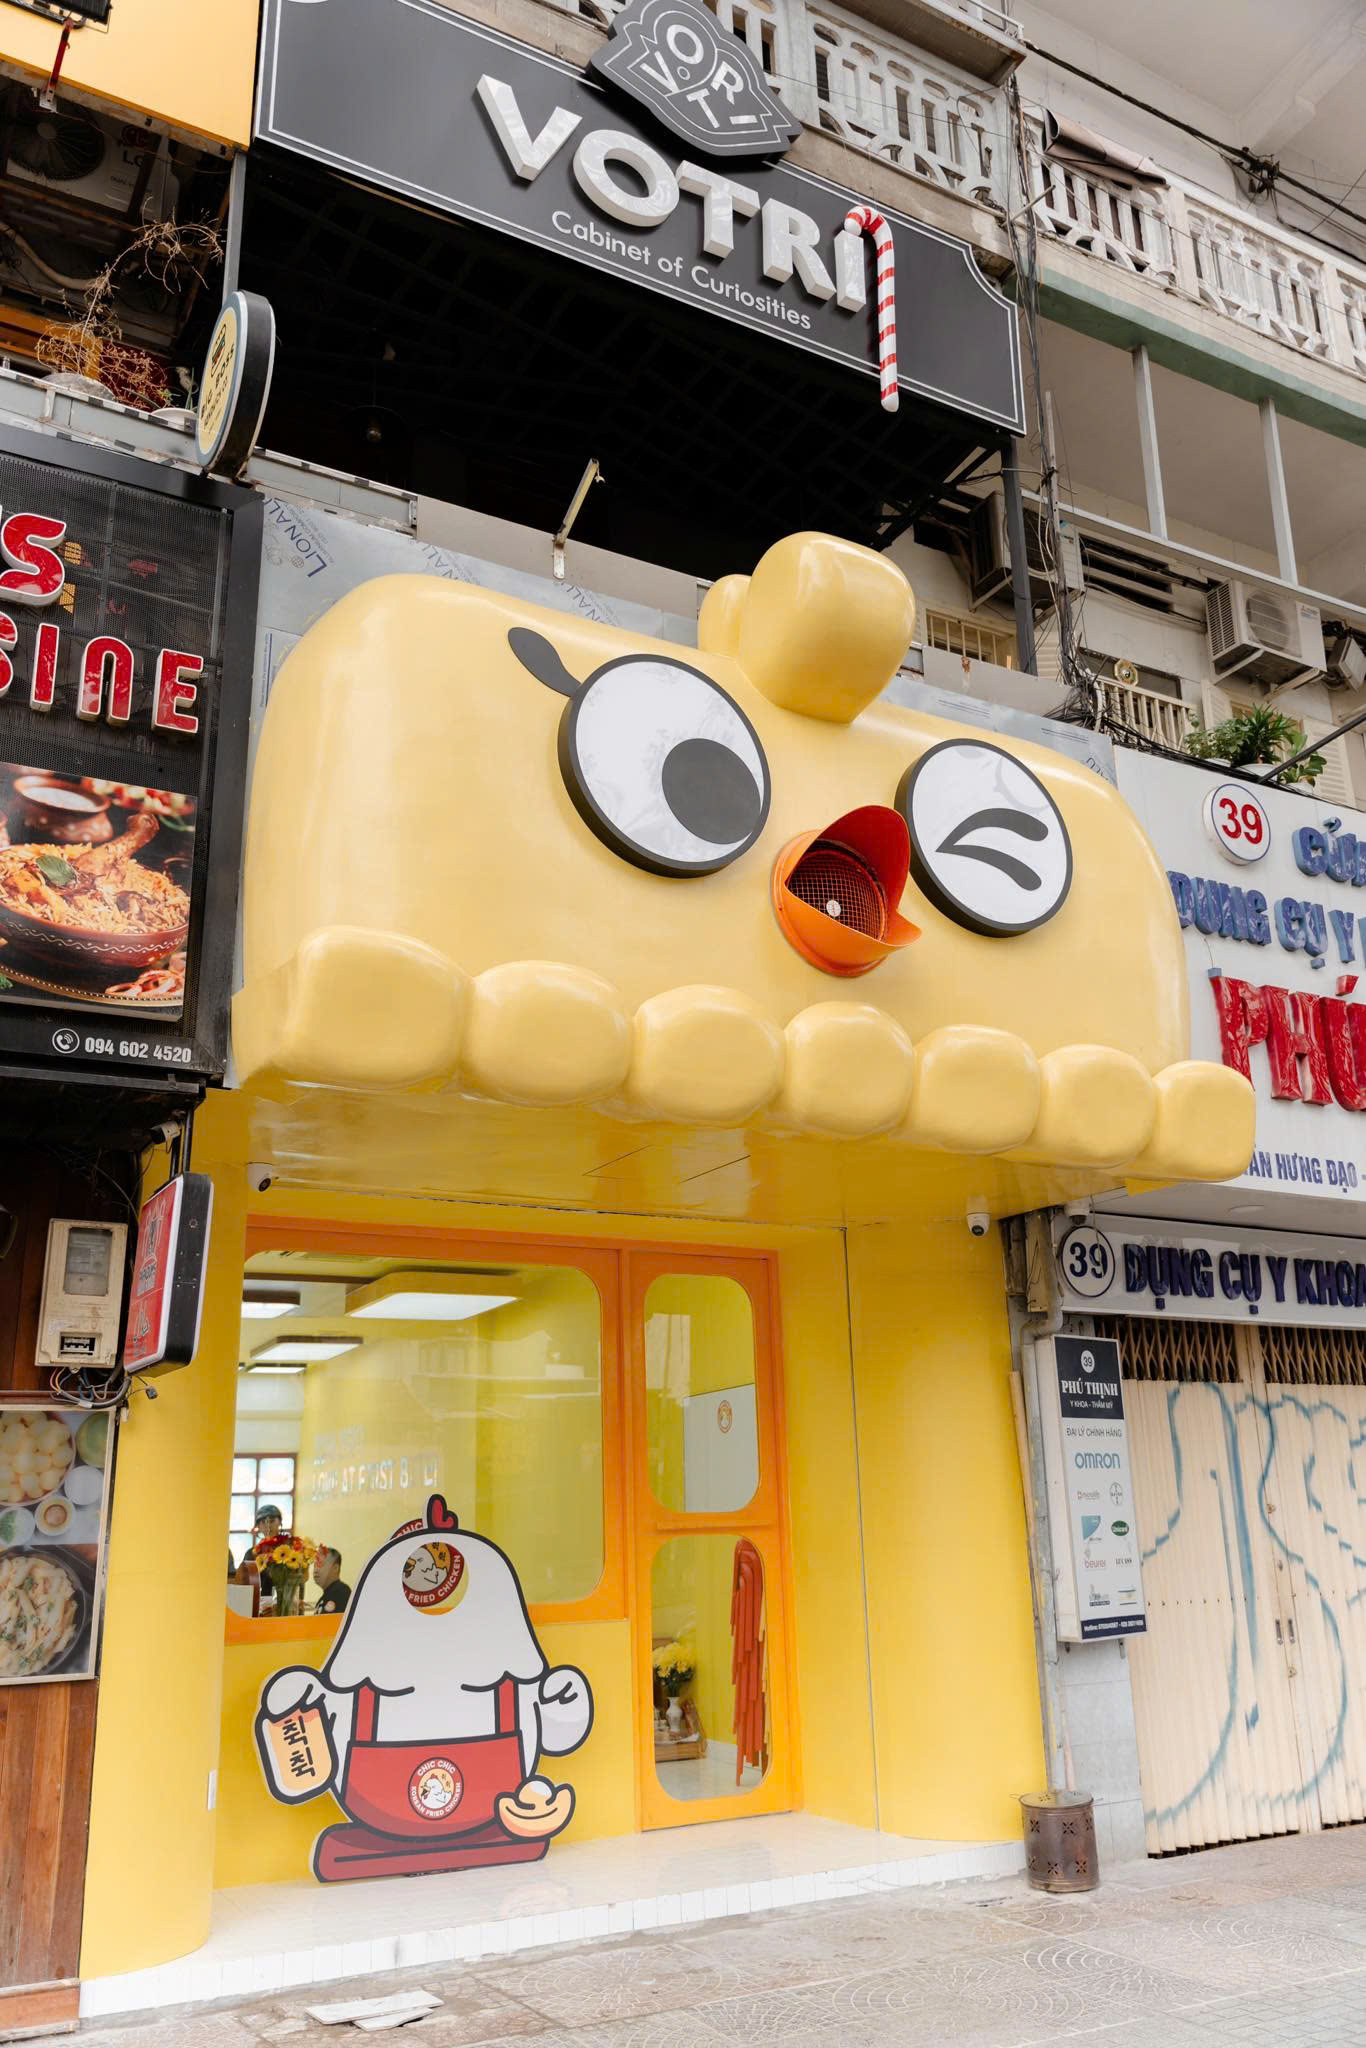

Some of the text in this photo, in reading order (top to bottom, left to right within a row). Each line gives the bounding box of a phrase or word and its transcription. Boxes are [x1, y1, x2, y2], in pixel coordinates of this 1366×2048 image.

[552, 210, 812, 330] Cabinet of Curiosities
[1218, 797, 1263, 846] 39
[1328, 908, 1355, 965] Y
[85, 1037, 192, 1063] 094 602 4520
[1275, 1152, 1323, 1184] HƯNG
[1325, 1160, 1359, 1193] ĐẠO
[1069, 1241, 1108, 1279] 39
[1123, 1243, 1215, 1310] DỤNG
[1219, 1250, 1262, 1314] CỤ
[1265, 1255, 1288, 1303] Y
[1083, 1356, 1093, 1368] 39
[1061, 1377, 1118, 1399] PHÚ THỊNH
[1074, 1400, 1088, 1409] KHOA
[408, 1554, 461, 1603] FRIED CHICKEN
[417, 1759, 456, 1776] CHIC CHIC
